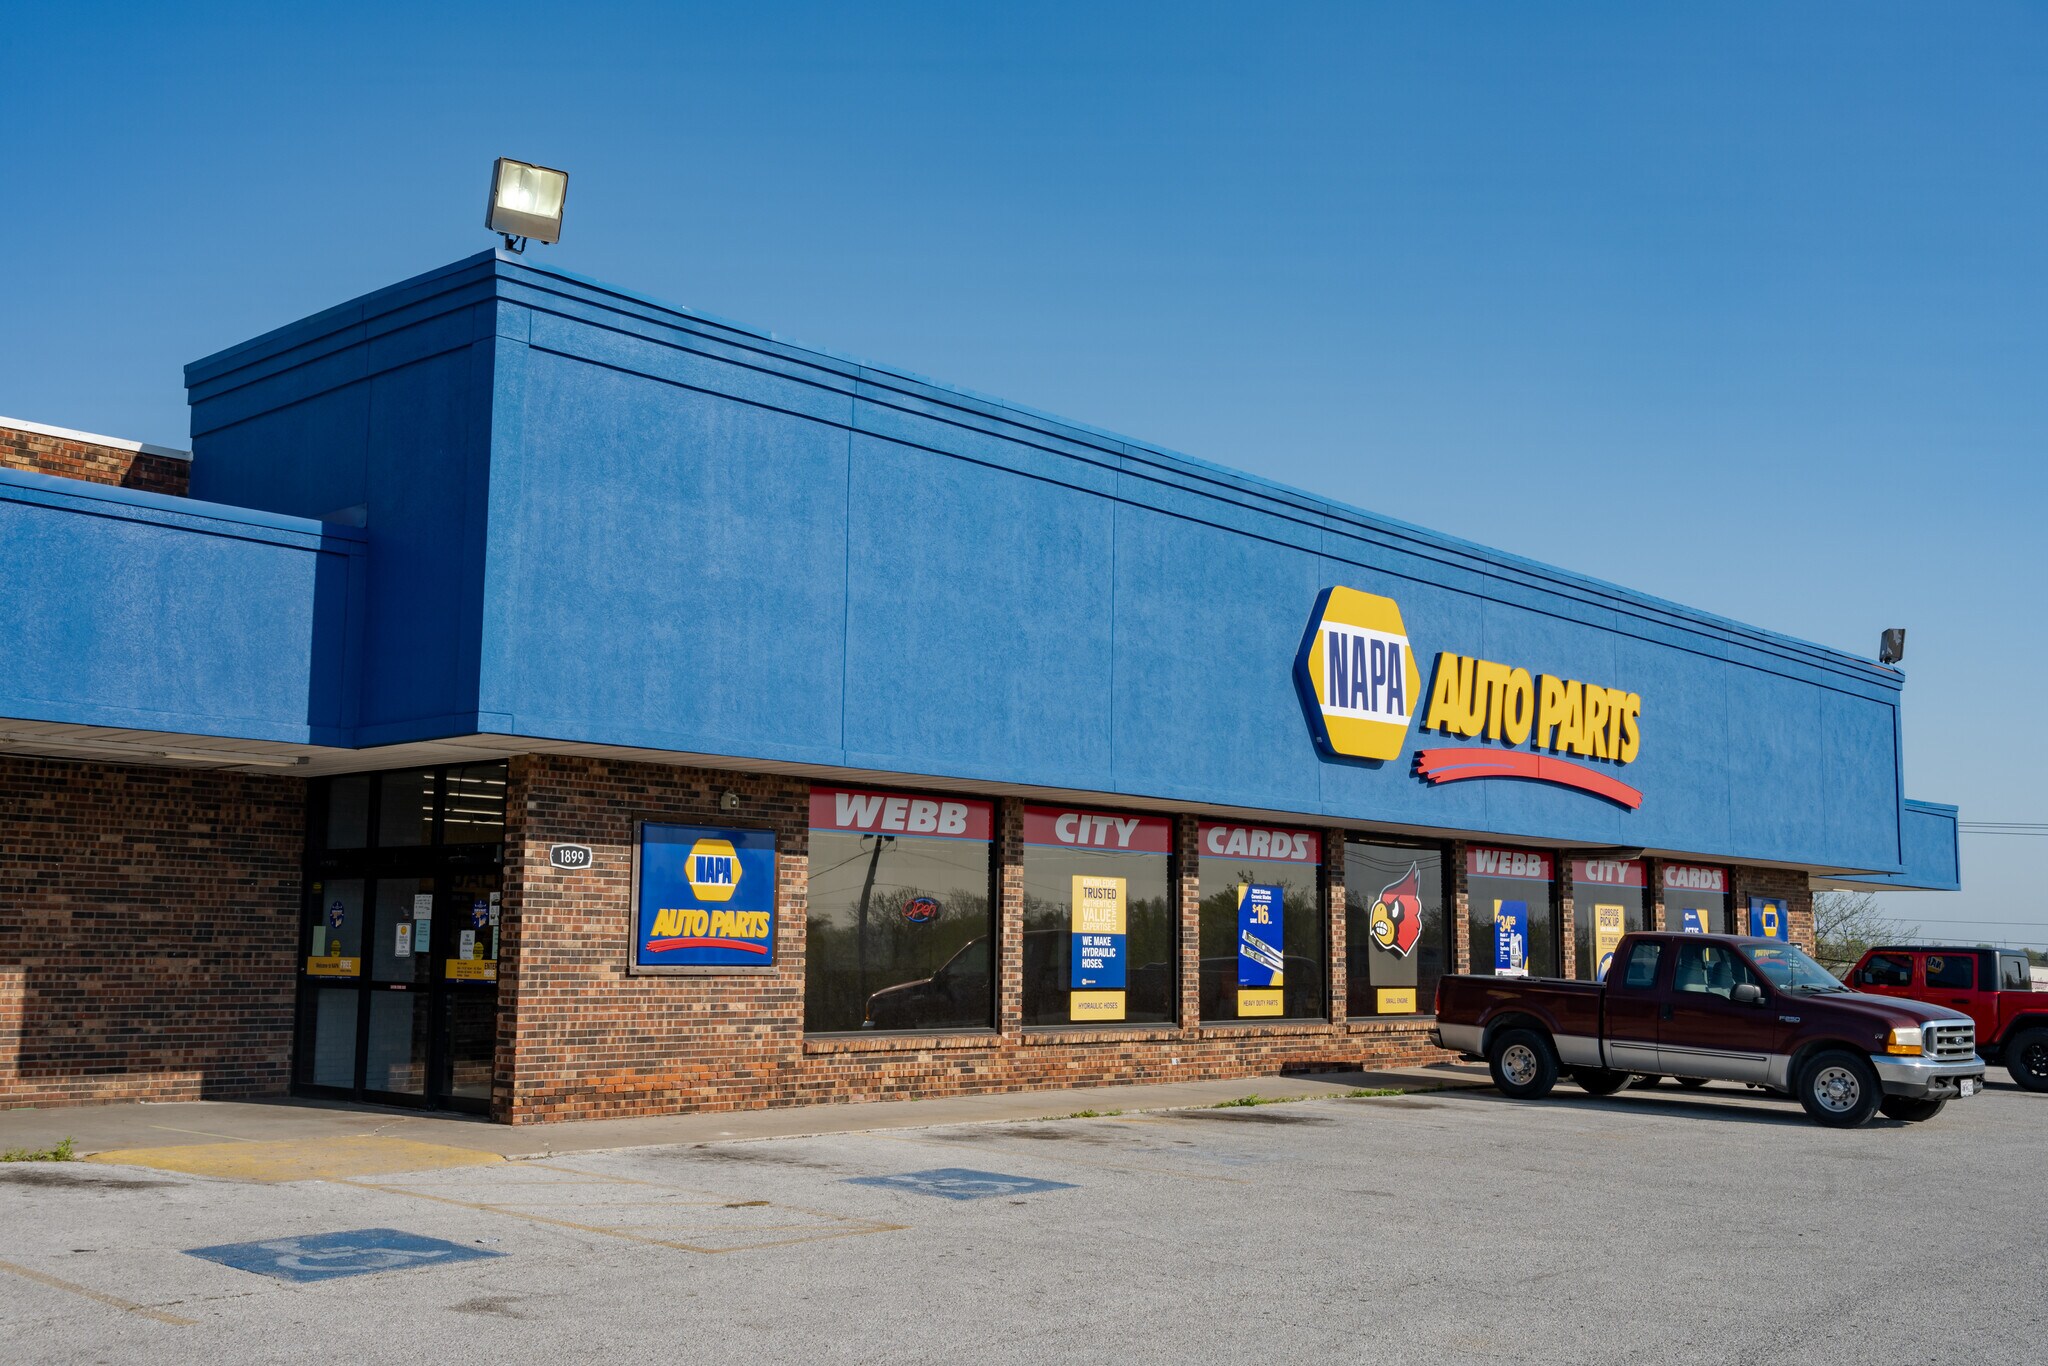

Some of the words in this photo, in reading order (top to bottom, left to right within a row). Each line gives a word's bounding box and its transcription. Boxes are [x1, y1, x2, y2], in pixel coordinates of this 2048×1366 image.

[1328, 631, 1404, 716] NAPA
[1424, 651, 1534, 745] AUTO
[1535, 674, 1641, 764] PARTS
[835, 793, 969, 835] WEBB
[1055, 813, 1140, 847] CITY
[1207, 826, 1309, 860] CARDS
[560, 850, 584, 864] 1899
[1475, 849, 1541, 878] WEBB
[696, 856, 732, 884] NAPA
[1585, 860, 1630, 883] CITY
[1665, 866, 1722, 890] CARDS
[1083, 887, 1117, 900] TRUSTED
[651, 908, 709, 937] AUTO
[709, 910, 771, 939] PARTS
[1083, 907, 1112, 922] VALUE
[1252, 904, 1269, 924] $16
[1600, 917, 1611, 926] PICK
[1082, 936, 1092, 946] WE
[1094, 936, 1111, 946] MAKE
[1082, 947, 1116, 957] HYDRAULIC
[1082, 959, 1104, 968] HOSES.
